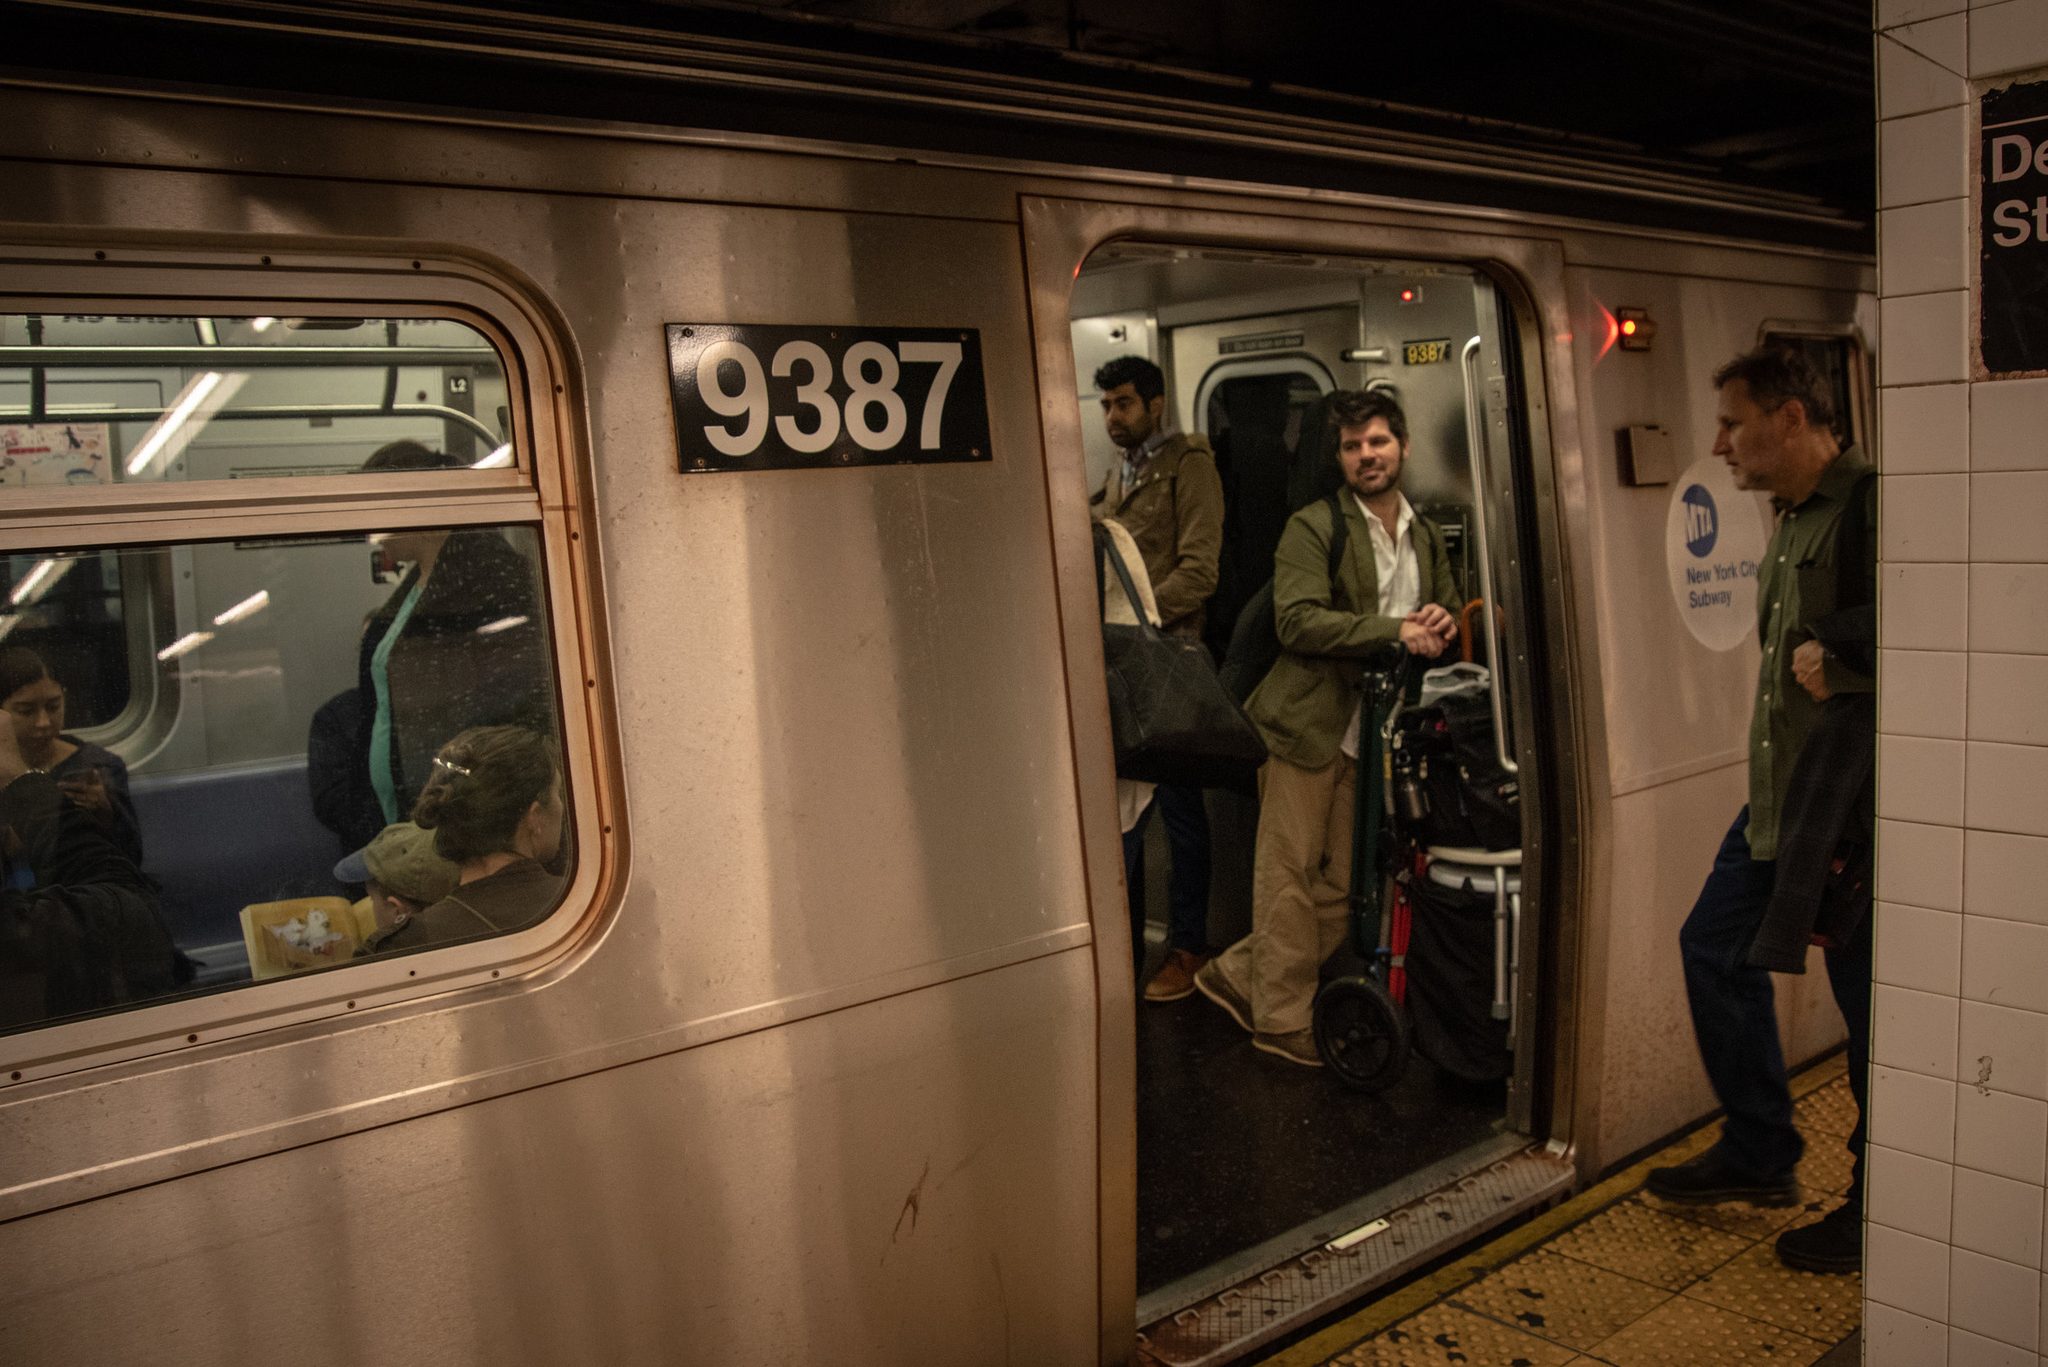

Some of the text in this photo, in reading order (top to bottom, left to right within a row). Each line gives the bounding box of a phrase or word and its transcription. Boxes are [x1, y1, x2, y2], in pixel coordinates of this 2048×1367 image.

[1993, 195, 2048, 247] St
[1407, 340, 1446, 364] 9387
[696, 340, 963, 457] 9387
[1686, 566, 1711, 585] New
[1713, 562, 1738, 581] York
[1689, 588, 1732, 609] Subway
